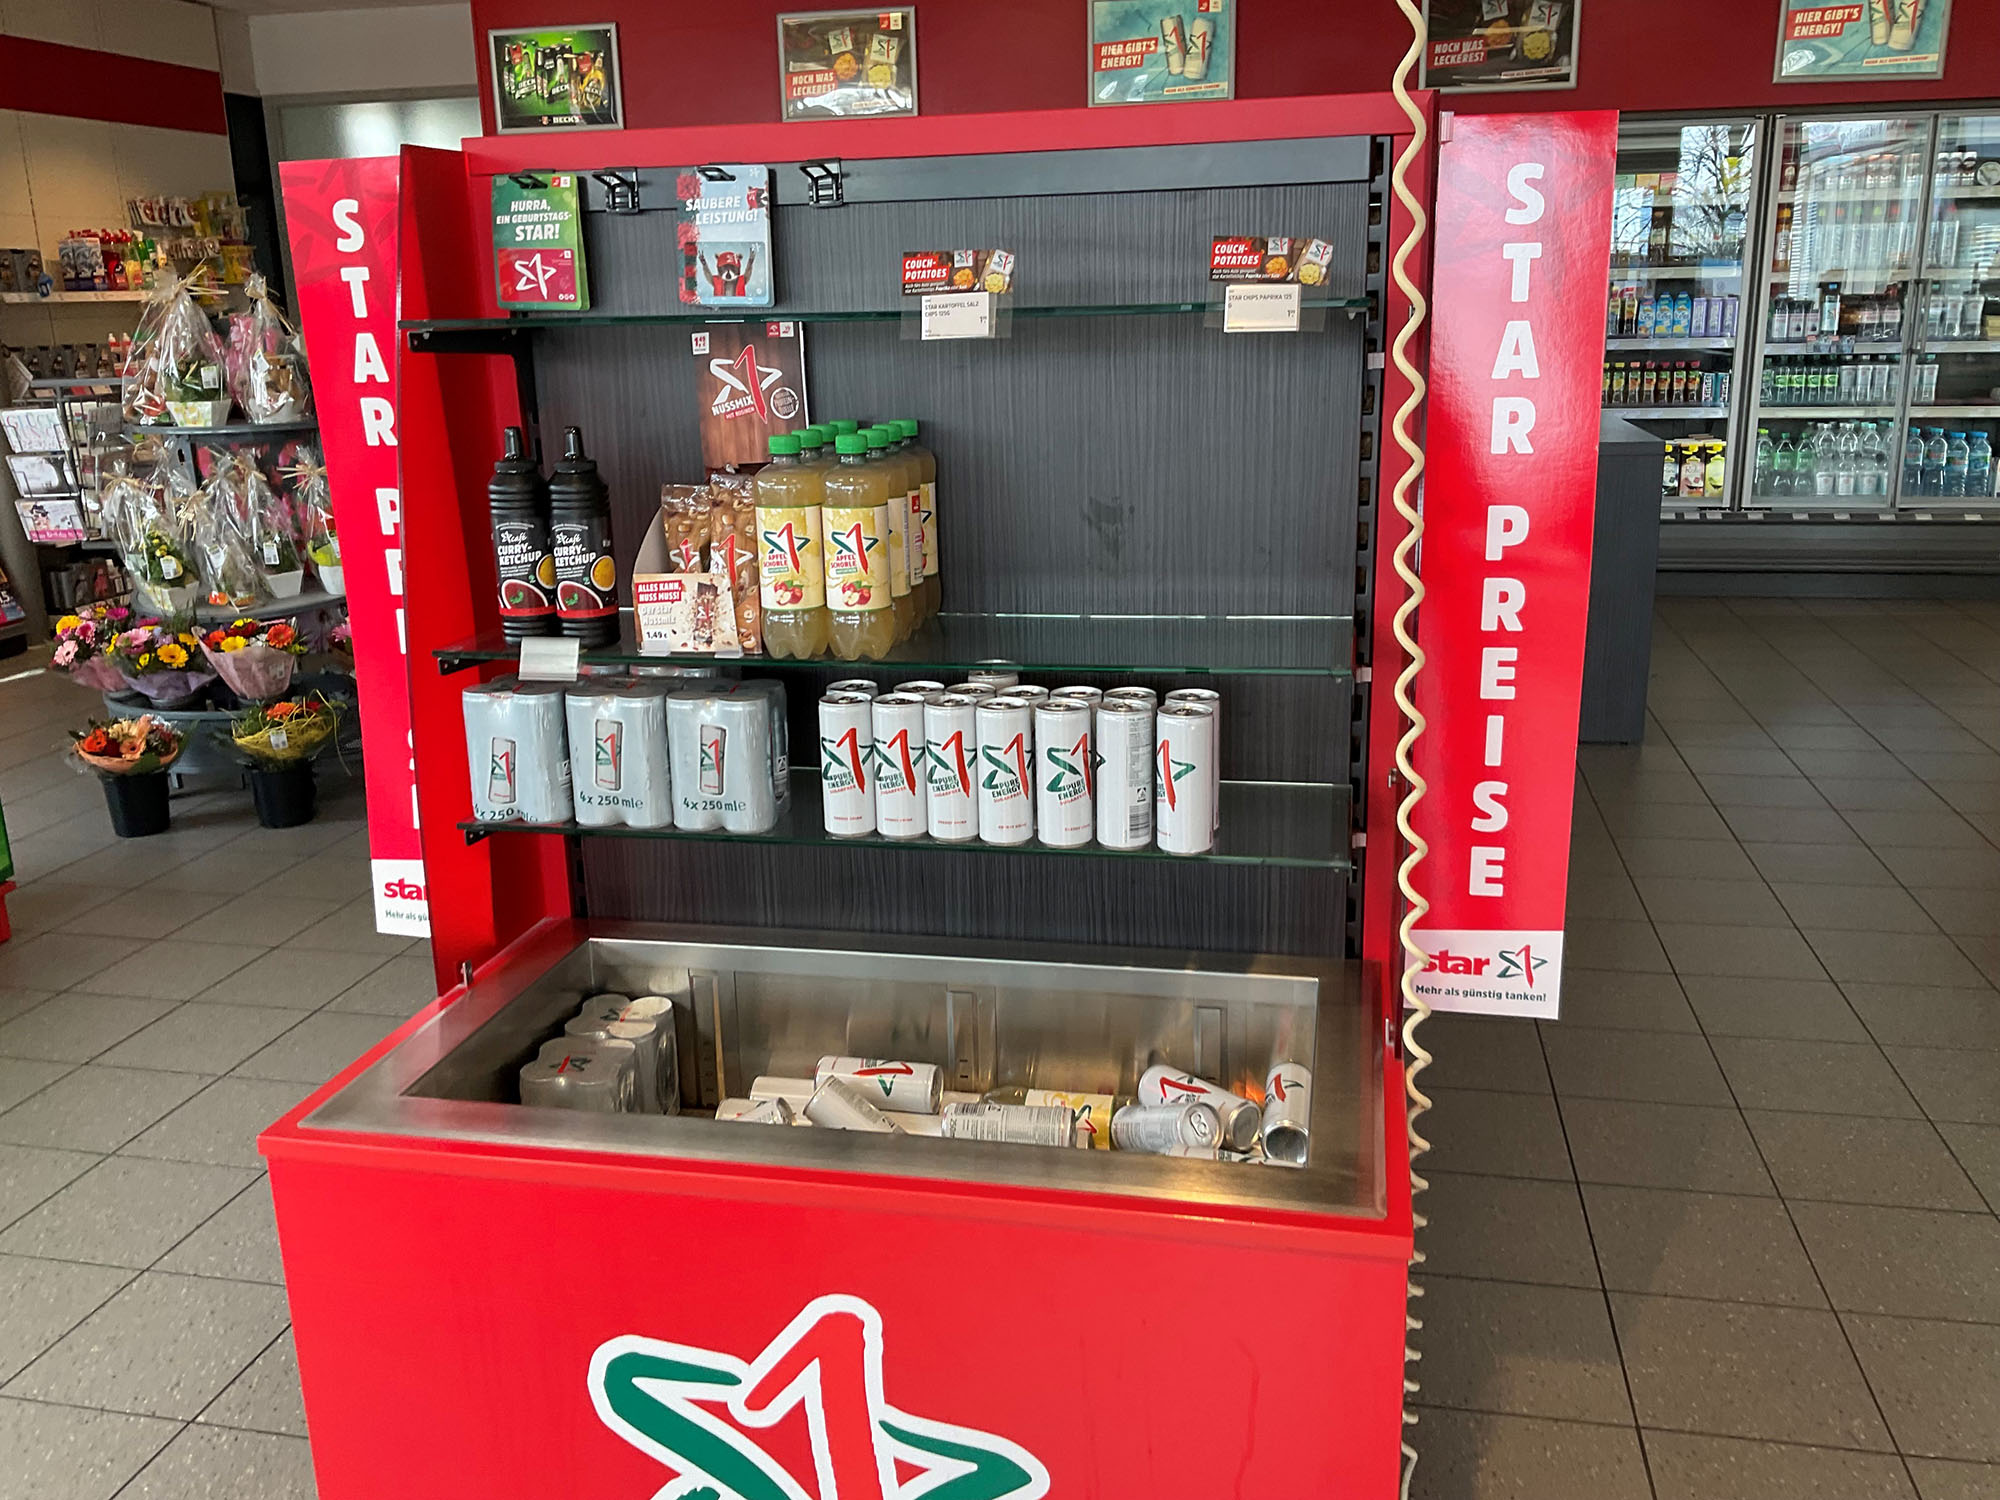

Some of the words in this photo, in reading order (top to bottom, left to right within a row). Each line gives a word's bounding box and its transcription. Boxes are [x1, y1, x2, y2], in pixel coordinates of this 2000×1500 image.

[1795, 11, 1821, 24] HIER
[1824, 7, 1860, 21] GIBT'S
[1793, 23, 1842, 37] ENERGY!
[1101, 45, 1123, 56] HIER
[1125, 41, 1156, 53] GIBT'S
[1462, 40, 1484, 53] WAS
[1101, 55, 1141, 69] ENERGY!
[1434, 52, 1484, 66] LECKERES?
[816, 72, 834, 82] WAS
[510, 199, 551, 212] HURRA,
[685, 196, 741, 211] SAUBERE
[496, 215, 510, 225] EIN
[512, 211, 572, 224] GEBURTSTAGS-
[695, 211, 758, 225] LEISTUNG!
[515, 223, 560, 241] STAR!
[1214, 244, 1248, 254] COUCH-
[905, 258, 936, 269] COUCH-
[1213, 255, 1259, 266] POTATOES
[905, 268, 947, 280] POTATOES
[1490, 162, 1546, 454] STAR
[332, 198, 398, 446] STAR
[712, 395, 754, 416] NUSSMIX
[510, 532, 527, 543] café
[567, 533, 581, 545] café
[498, 543, 532, 556] CURRY-
[554, 544, 586, 556] CURRY-
[499, 551, 542, 566] KETCHUP
[555, 552, 596, 567] KETCHUP
[638, 582, 658, 592] ALLES
[639, 592, 659, 602] NUSS
[661, 591, 680, 601] MUSS!
[1469, 504, 1530, 897] PREISE
[828, 776, 855, 788] ENERGY
[833, 771, 852, 781] PURE
[884, 773, 903, 782] PURE
[938, 775, 958, 784] PURE
[879, 778, 905, 790] ENERGY
[933, 780, 960, 792] ENERGY
[998, 777, 1020, 789] PURE
[1064, 777, 1085, 790] PURE
[991, 785, 1021, 798] ENERGY
[1057, 786, 1086, 800] ENERGY
[579, 791, 593, 805] 4x
[597, 795, 620, 806] 250
[683, 797, 698, 810] 4x
[702, 800, 723, 811] 250
[489, 807, 514, 821] 250
[385, 909, 404, 919] Mehr
[406, 912, 416, 920] als
[1420, 949, 1490, 976] star
[1416, 985, 1441, 995] Mehr
[1445, 986, 1460, 996] als
[1463, 987, 1502, 1000] günstig
[1506, 992, 1546, 1002] tanken!
